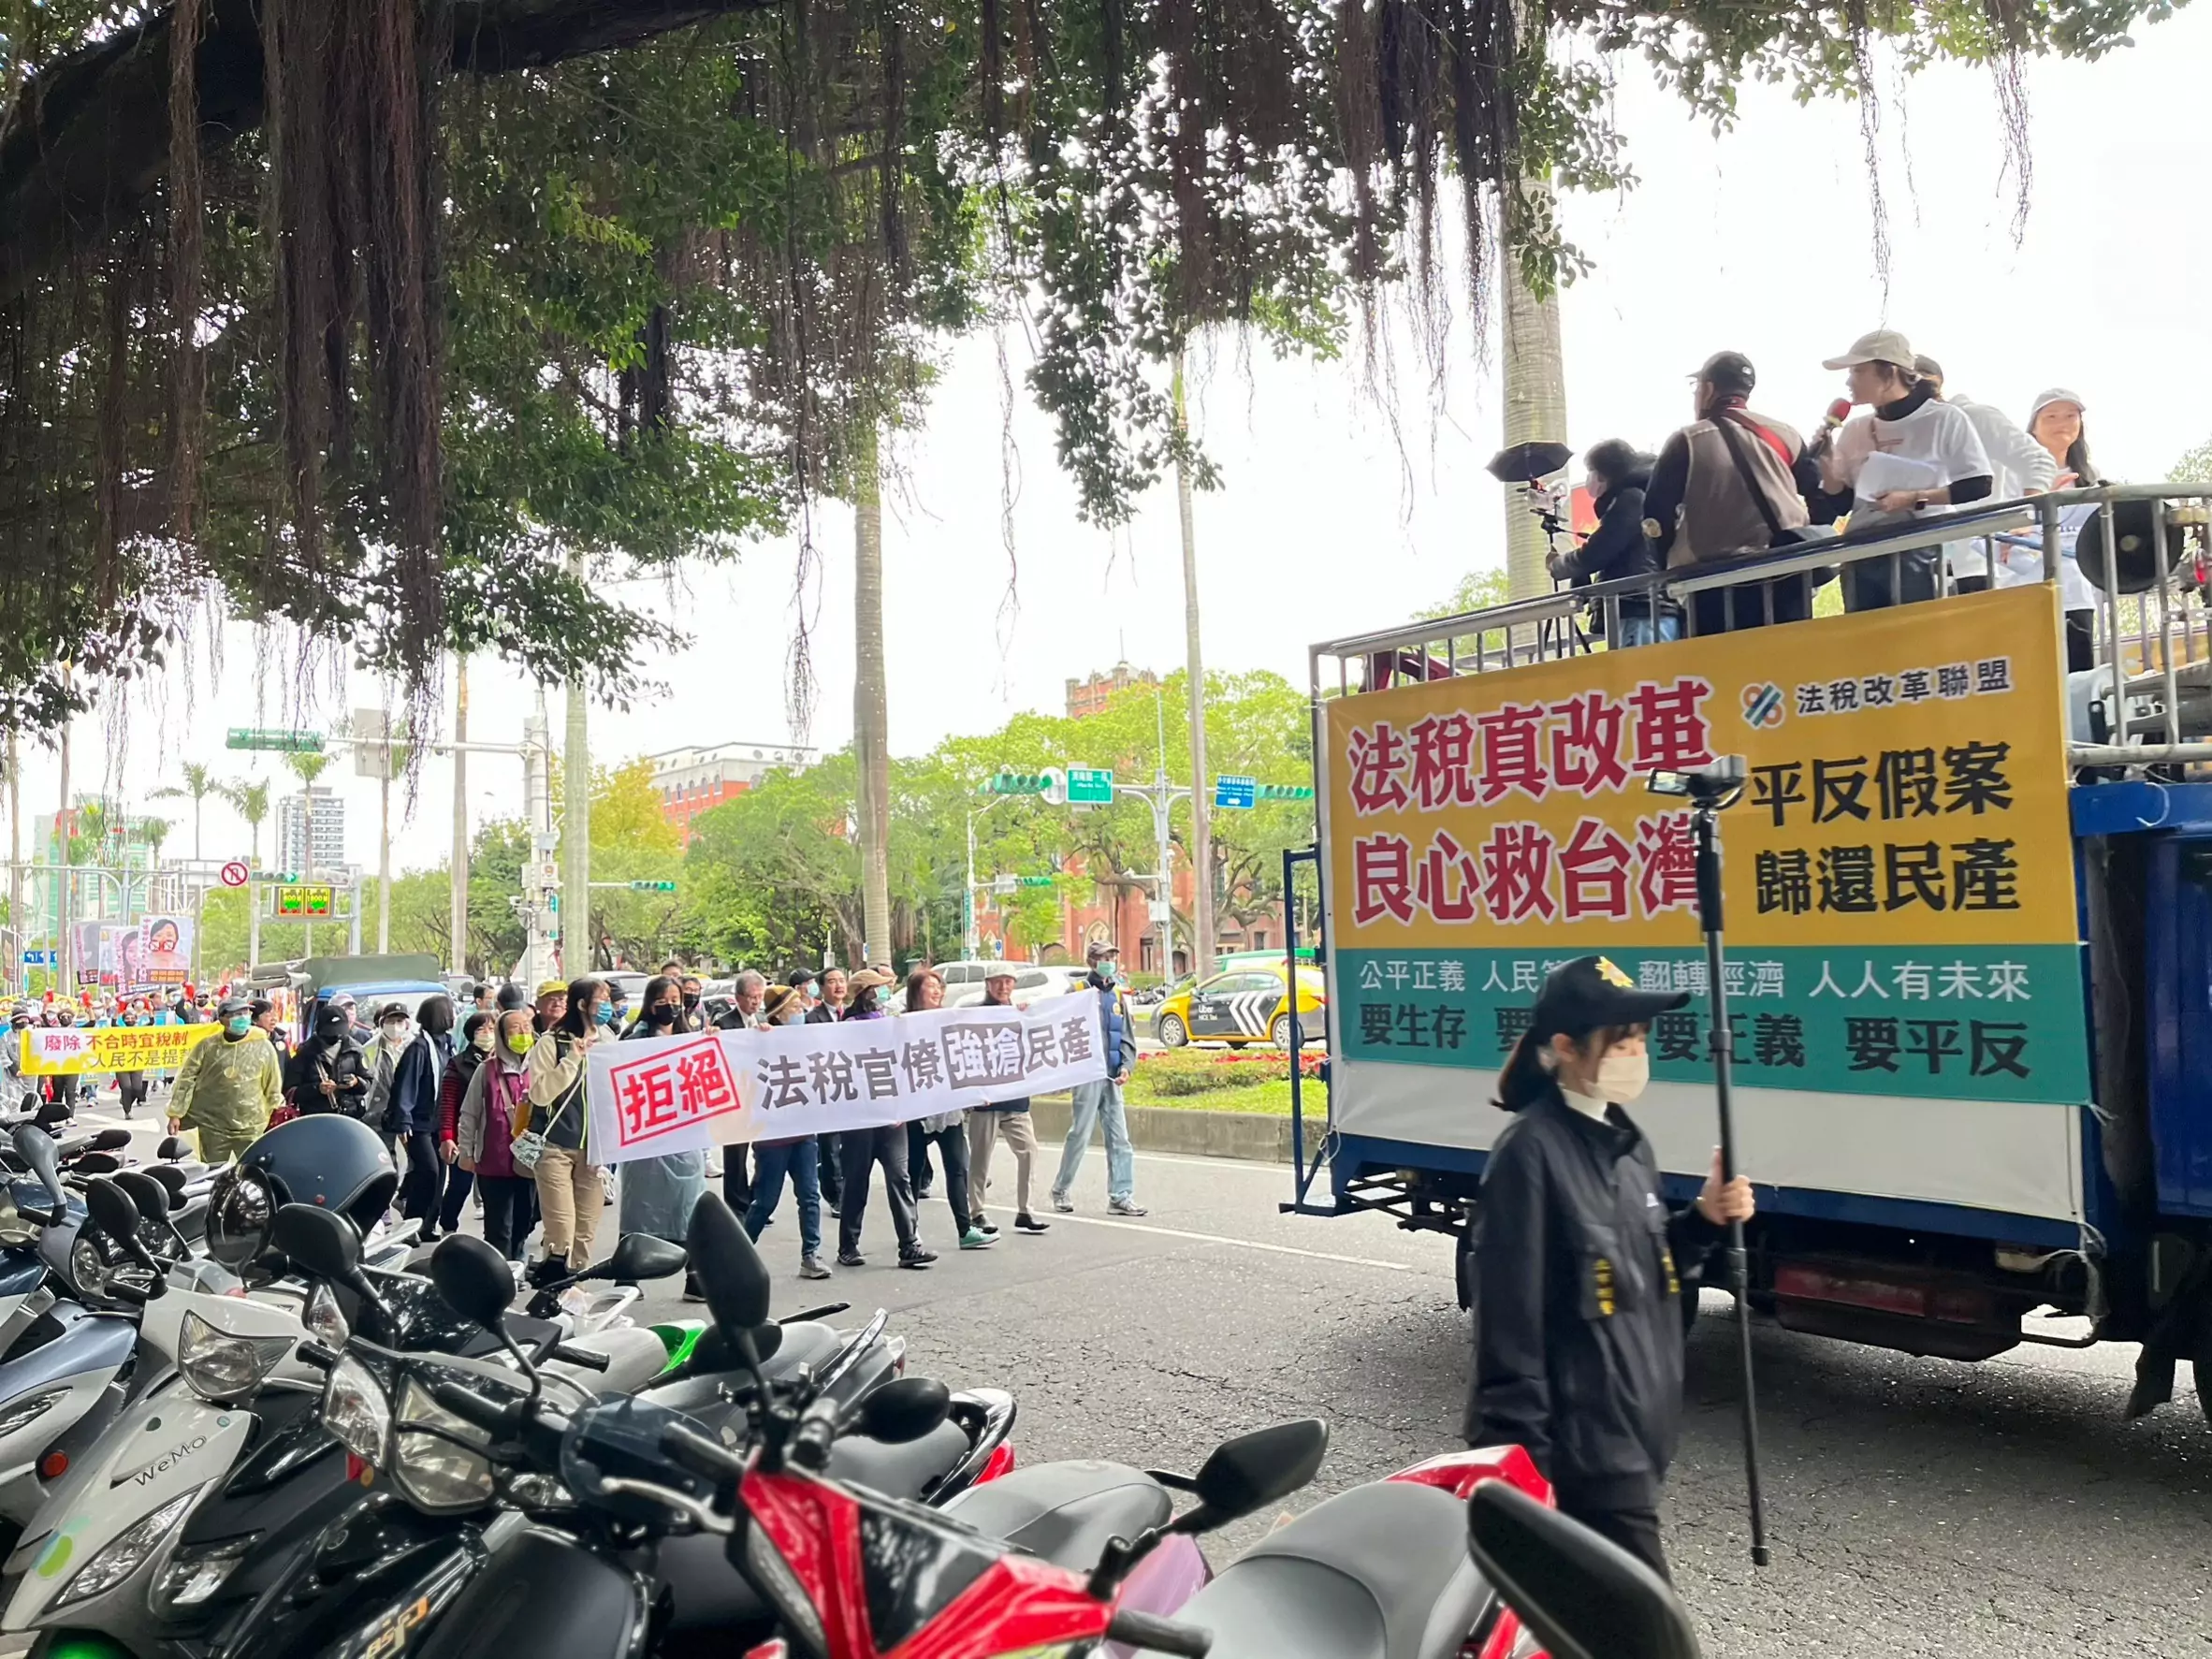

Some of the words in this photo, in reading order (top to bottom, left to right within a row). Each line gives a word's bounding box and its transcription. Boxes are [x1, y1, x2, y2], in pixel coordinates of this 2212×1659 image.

[1797, 659, 2010, 714] 法稅改革聯盟
[1348, 679, 1717, 812] 法稅真改革
[1750, 741, 2013, 826] 平反假案
[1755, 837, 2021, 914] 歸還民產
[1199, 1005, 1214, 1013] Uber
[1360, 960, 1465, 992] 公平正義
[1482, 959, 1561, 993] 人民
[1809, 960, 2031, 1001] 人人有未來
[45, 1035, 81, 1051] 廢除
[1360, 1003, 1466, 1049] 要生存
[1845, 1016, 2030, 1079] 要平反
[622, 1047, 731, 1133] 拒絕
[135, 1435, 206, 1486] WeMo
